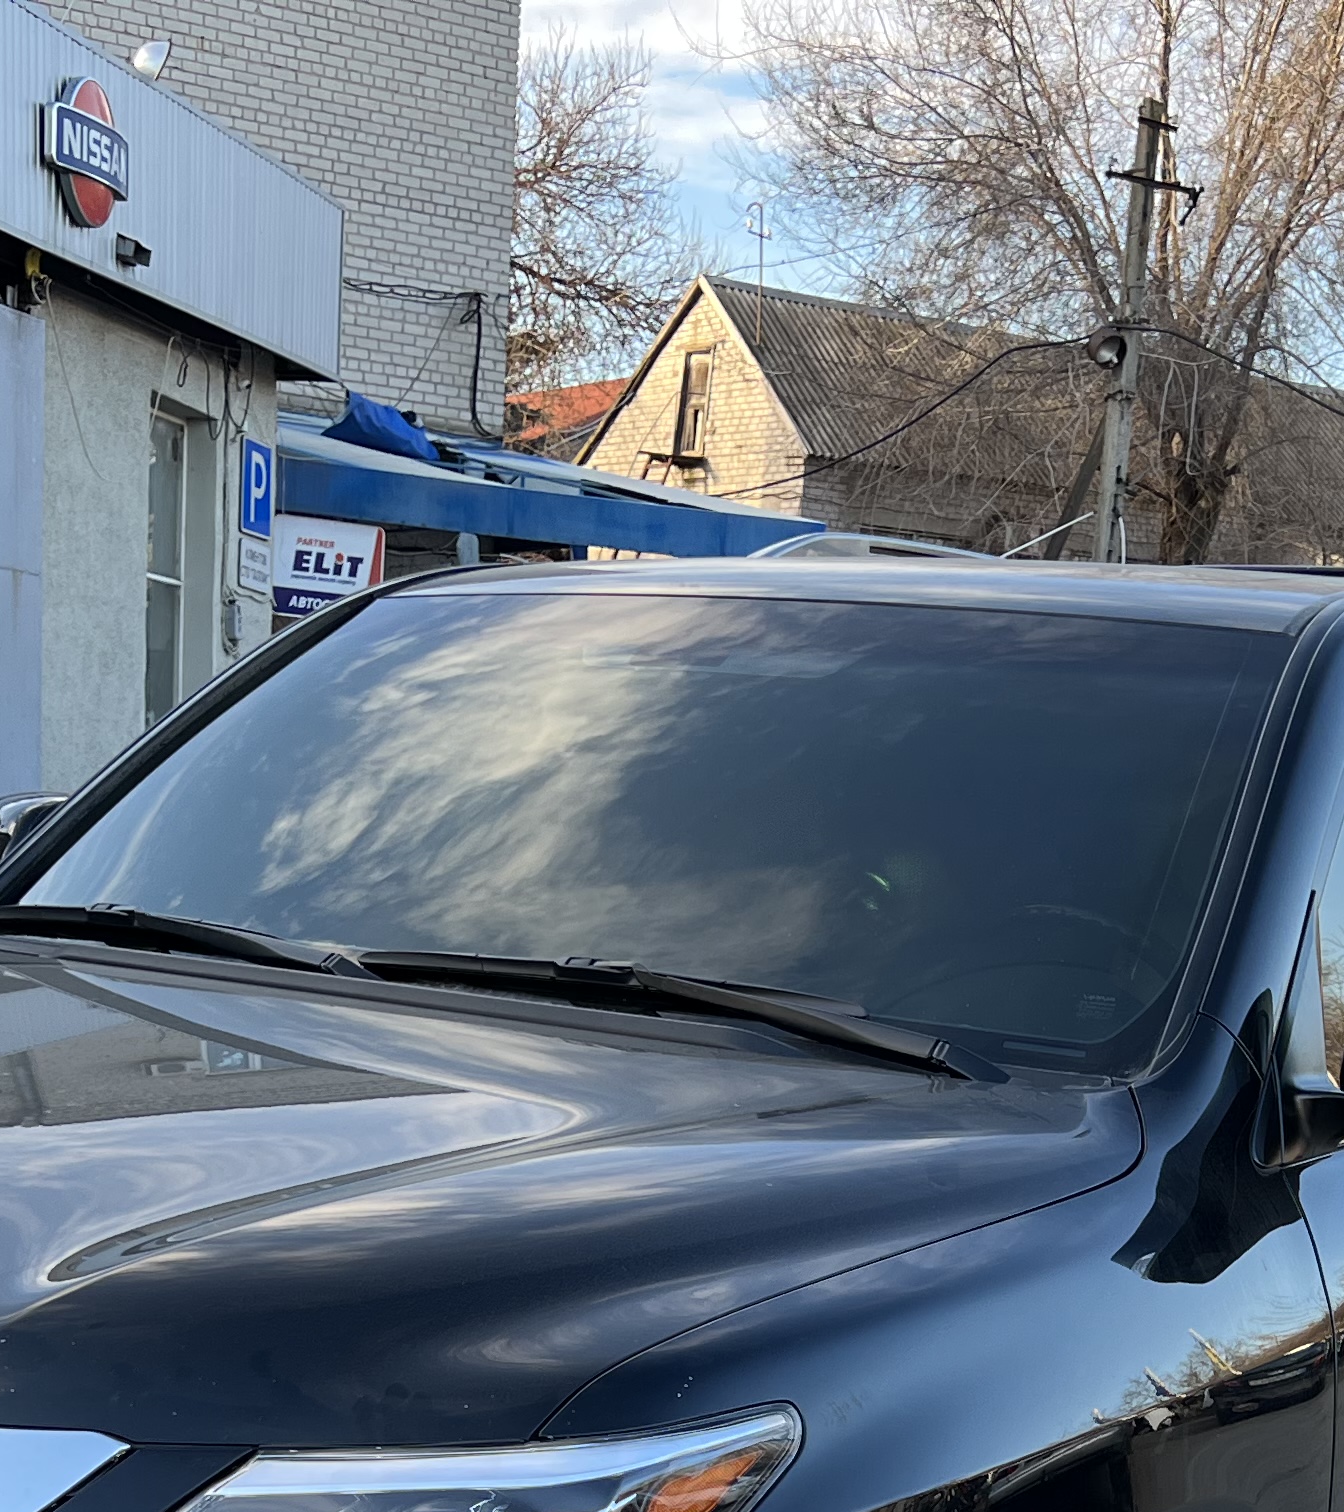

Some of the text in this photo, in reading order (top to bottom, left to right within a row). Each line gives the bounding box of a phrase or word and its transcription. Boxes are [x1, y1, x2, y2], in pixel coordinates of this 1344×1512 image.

[62, 118, 127, 186] NISSAN
[250, 450, 267, 523] P
[296, 536, 335, 549] PARTNER
